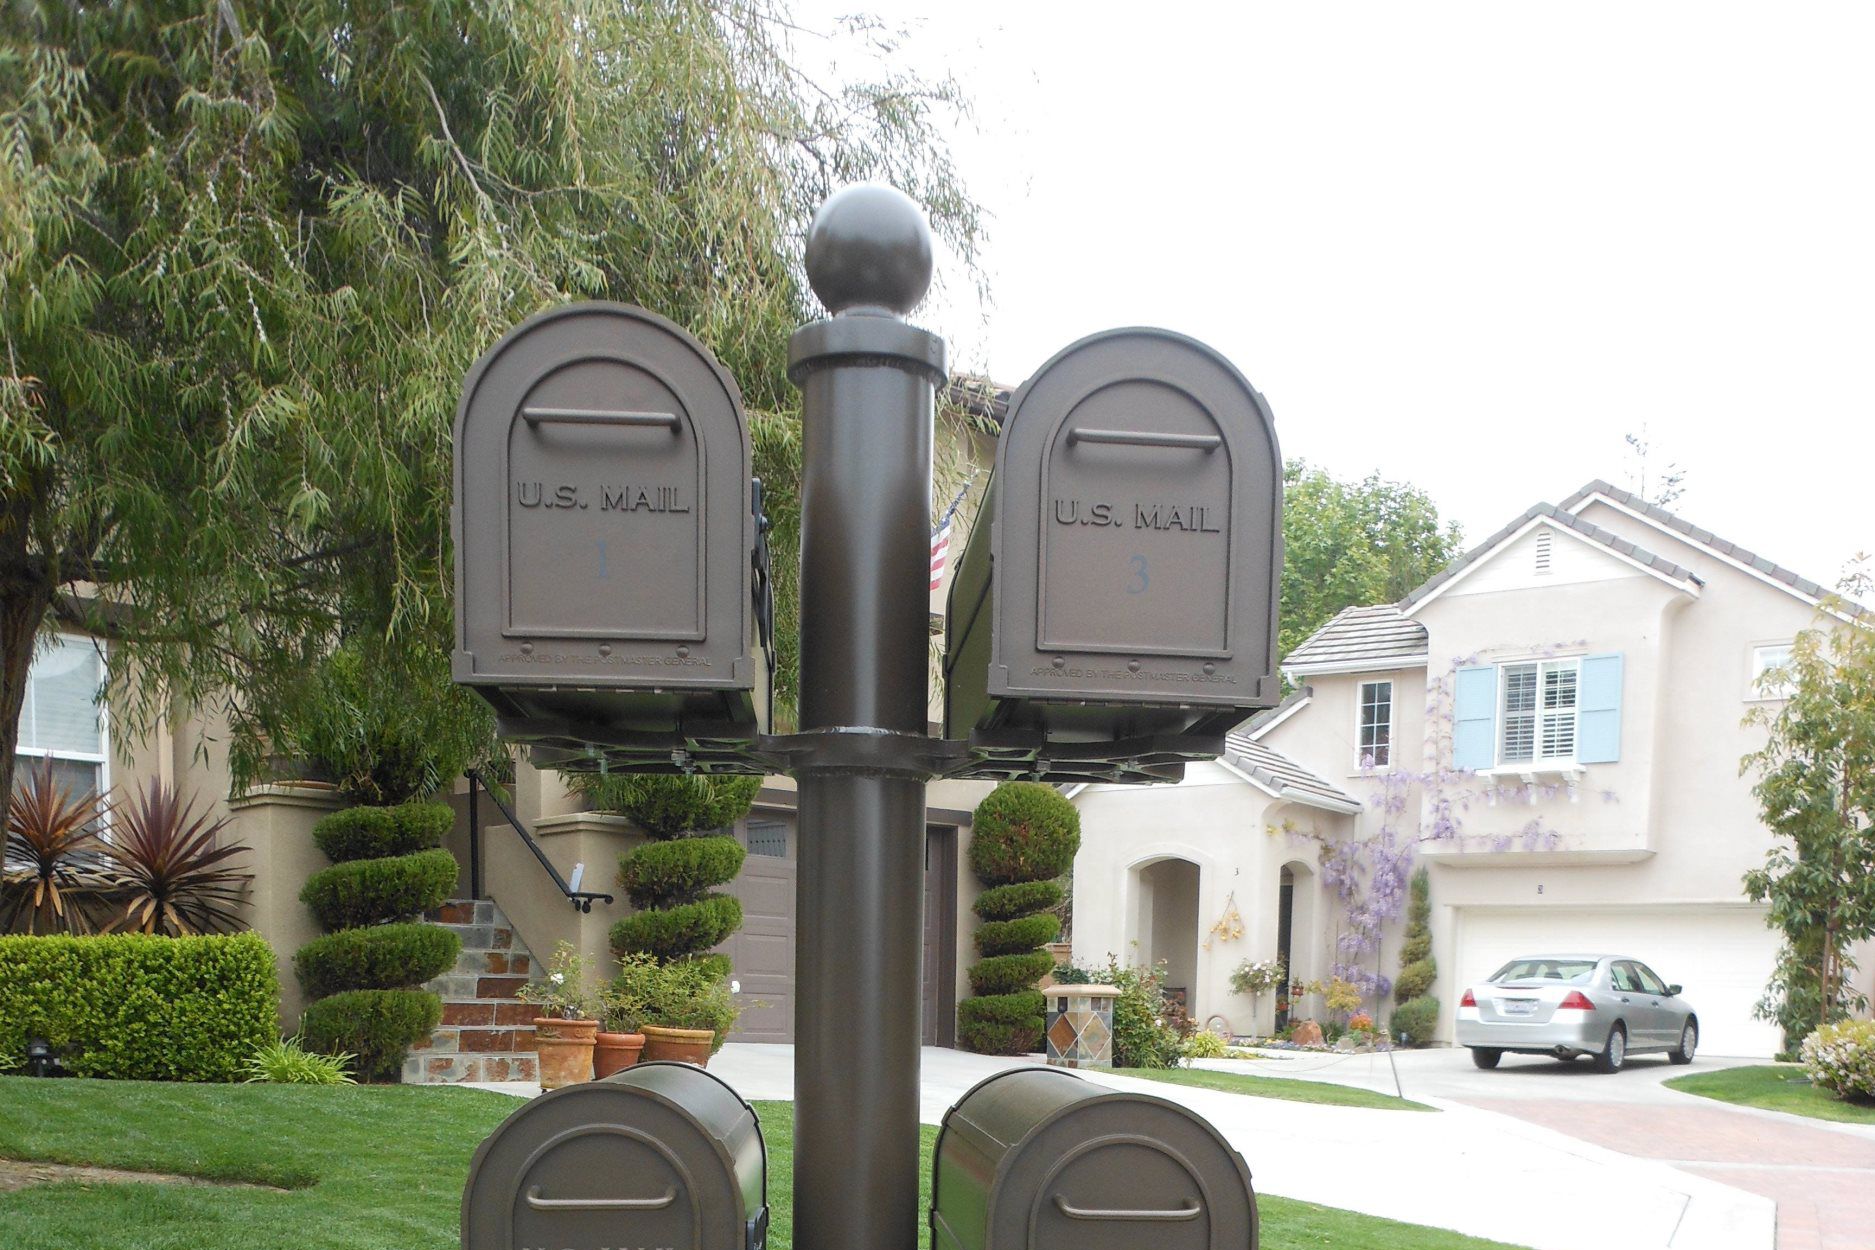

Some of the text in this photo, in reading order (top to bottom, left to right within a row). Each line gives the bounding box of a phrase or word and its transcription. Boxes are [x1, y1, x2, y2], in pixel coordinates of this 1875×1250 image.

[516, 481, 690, 513] U.S. MAIL
[1055, 499, 1221, 533] U.S. MAIL
[596, 539, 608, 579] 1
[1126, 554, 1149, 595] 3
[1030, 667, 1083, 678] APPROVED
